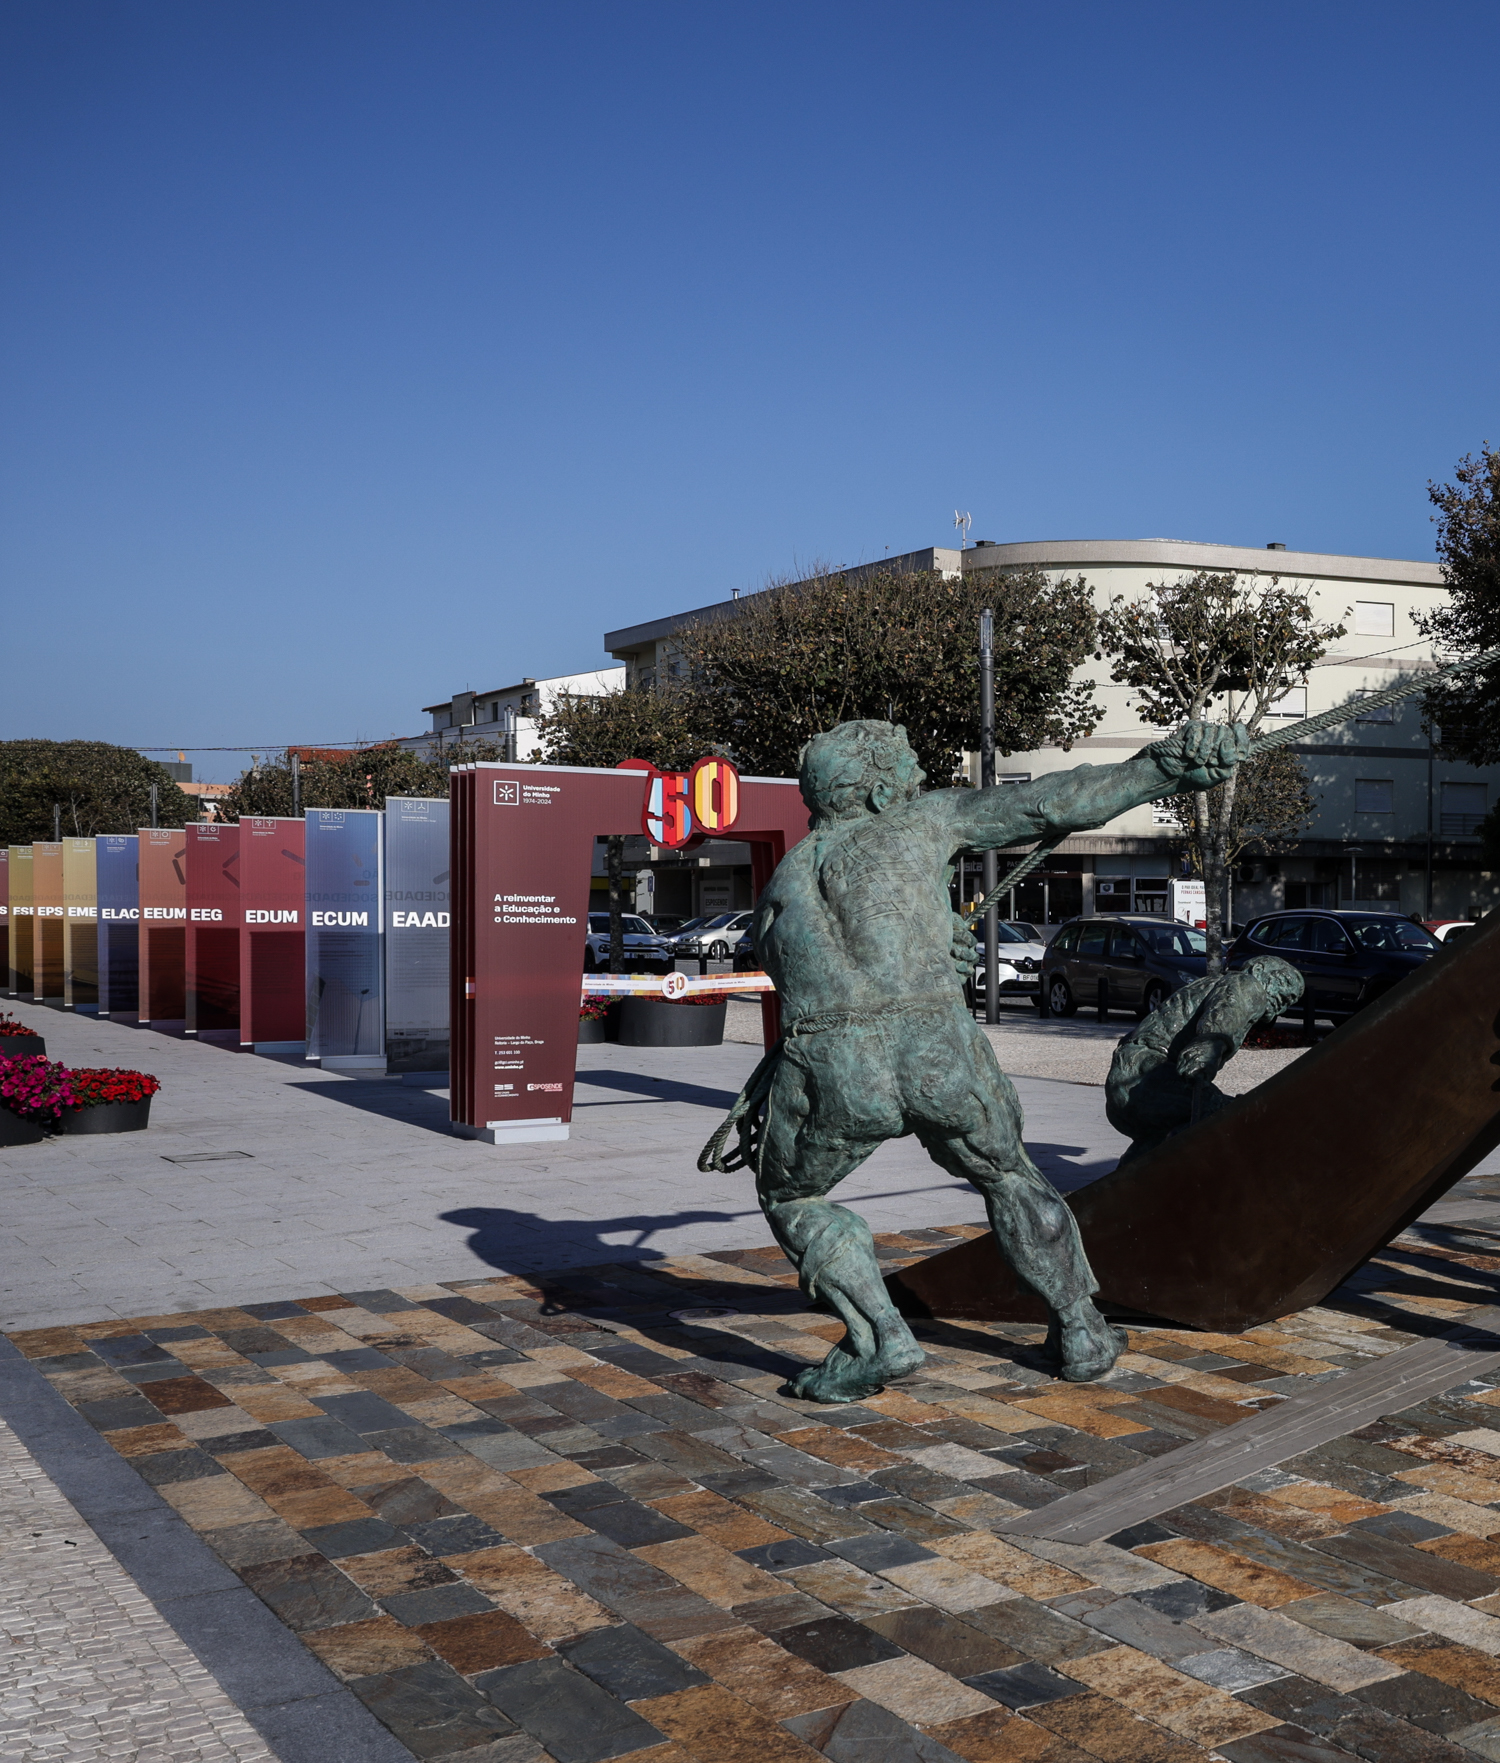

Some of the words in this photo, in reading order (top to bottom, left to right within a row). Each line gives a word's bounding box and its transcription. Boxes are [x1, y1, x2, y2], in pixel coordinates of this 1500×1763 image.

[646, 761, 738, 846] 50
[494, 894, 502, 902] A
[503, 893, 556, 903] reinventar
[37, 906, 64, 916] EPS
[67, 906, 97, 917] EME
[101, 908, 140, 919] ELAC
[143, 907, 187, 919] EEUM
[190, 908, 223, 921] EEG
[502, 904, 552, 915] Educação
[245, 909, 298, 924] EDUM
[312, 911, 368, 926] ECUM
[392, 911, 450, 928] EAAD
[503, 915, 577, 924] Conhecimento
[666, 977, 685, 995] 50
